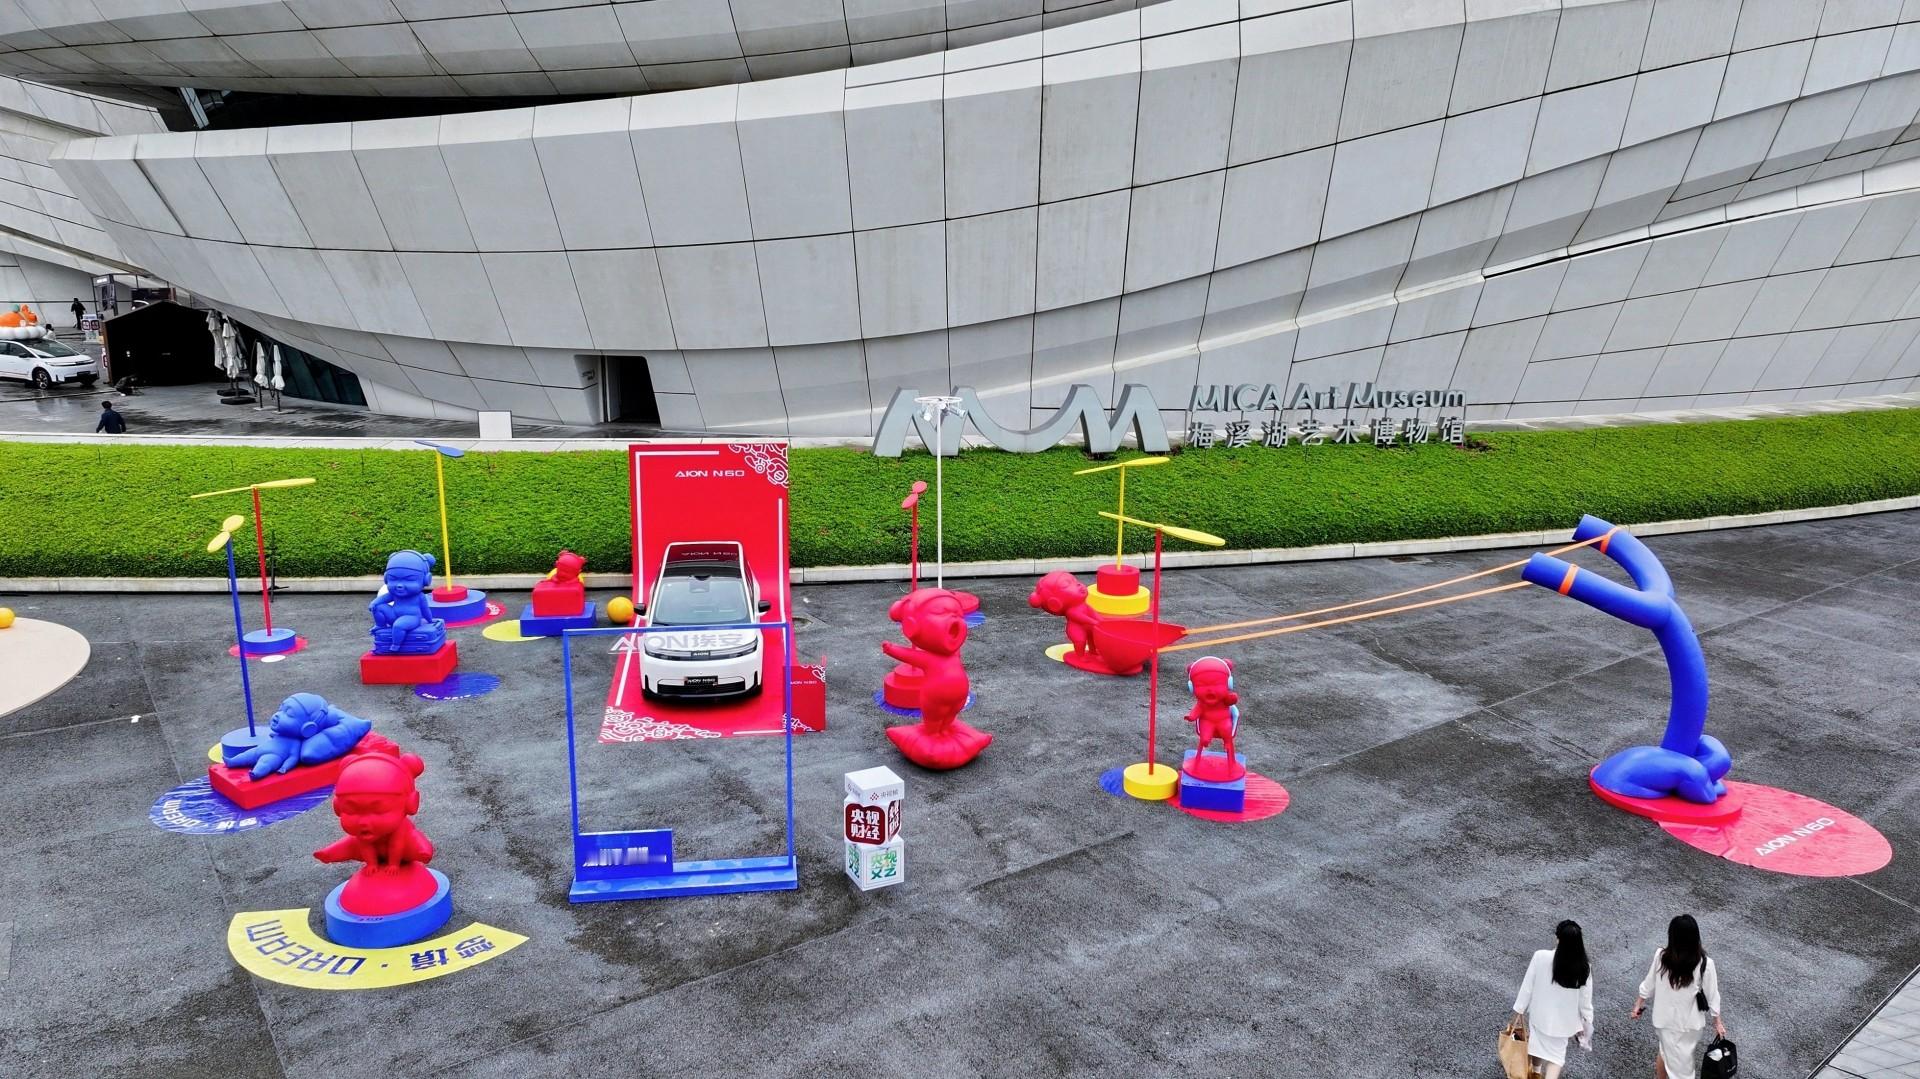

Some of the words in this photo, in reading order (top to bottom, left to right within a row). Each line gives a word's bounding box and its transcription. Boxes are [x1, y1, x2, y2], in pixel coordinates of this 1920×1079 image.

[1190, 383, 1283, 413] MICA
[1292, 382, 1342, 410] Art
[1349, 381, 1467, 408] Museum
[1189, 417, 1467, 448] 梅溪湖艺术博物馆
[674, 470, 708, 478] AION
[851, 809, 880, 826] 央视
[851, 824, 880, 840] 财经
[1755, 834, 1797, 856] AION
[1792, 817, 1835, 837] N60
[246, 919, 367, 976] DREAM
